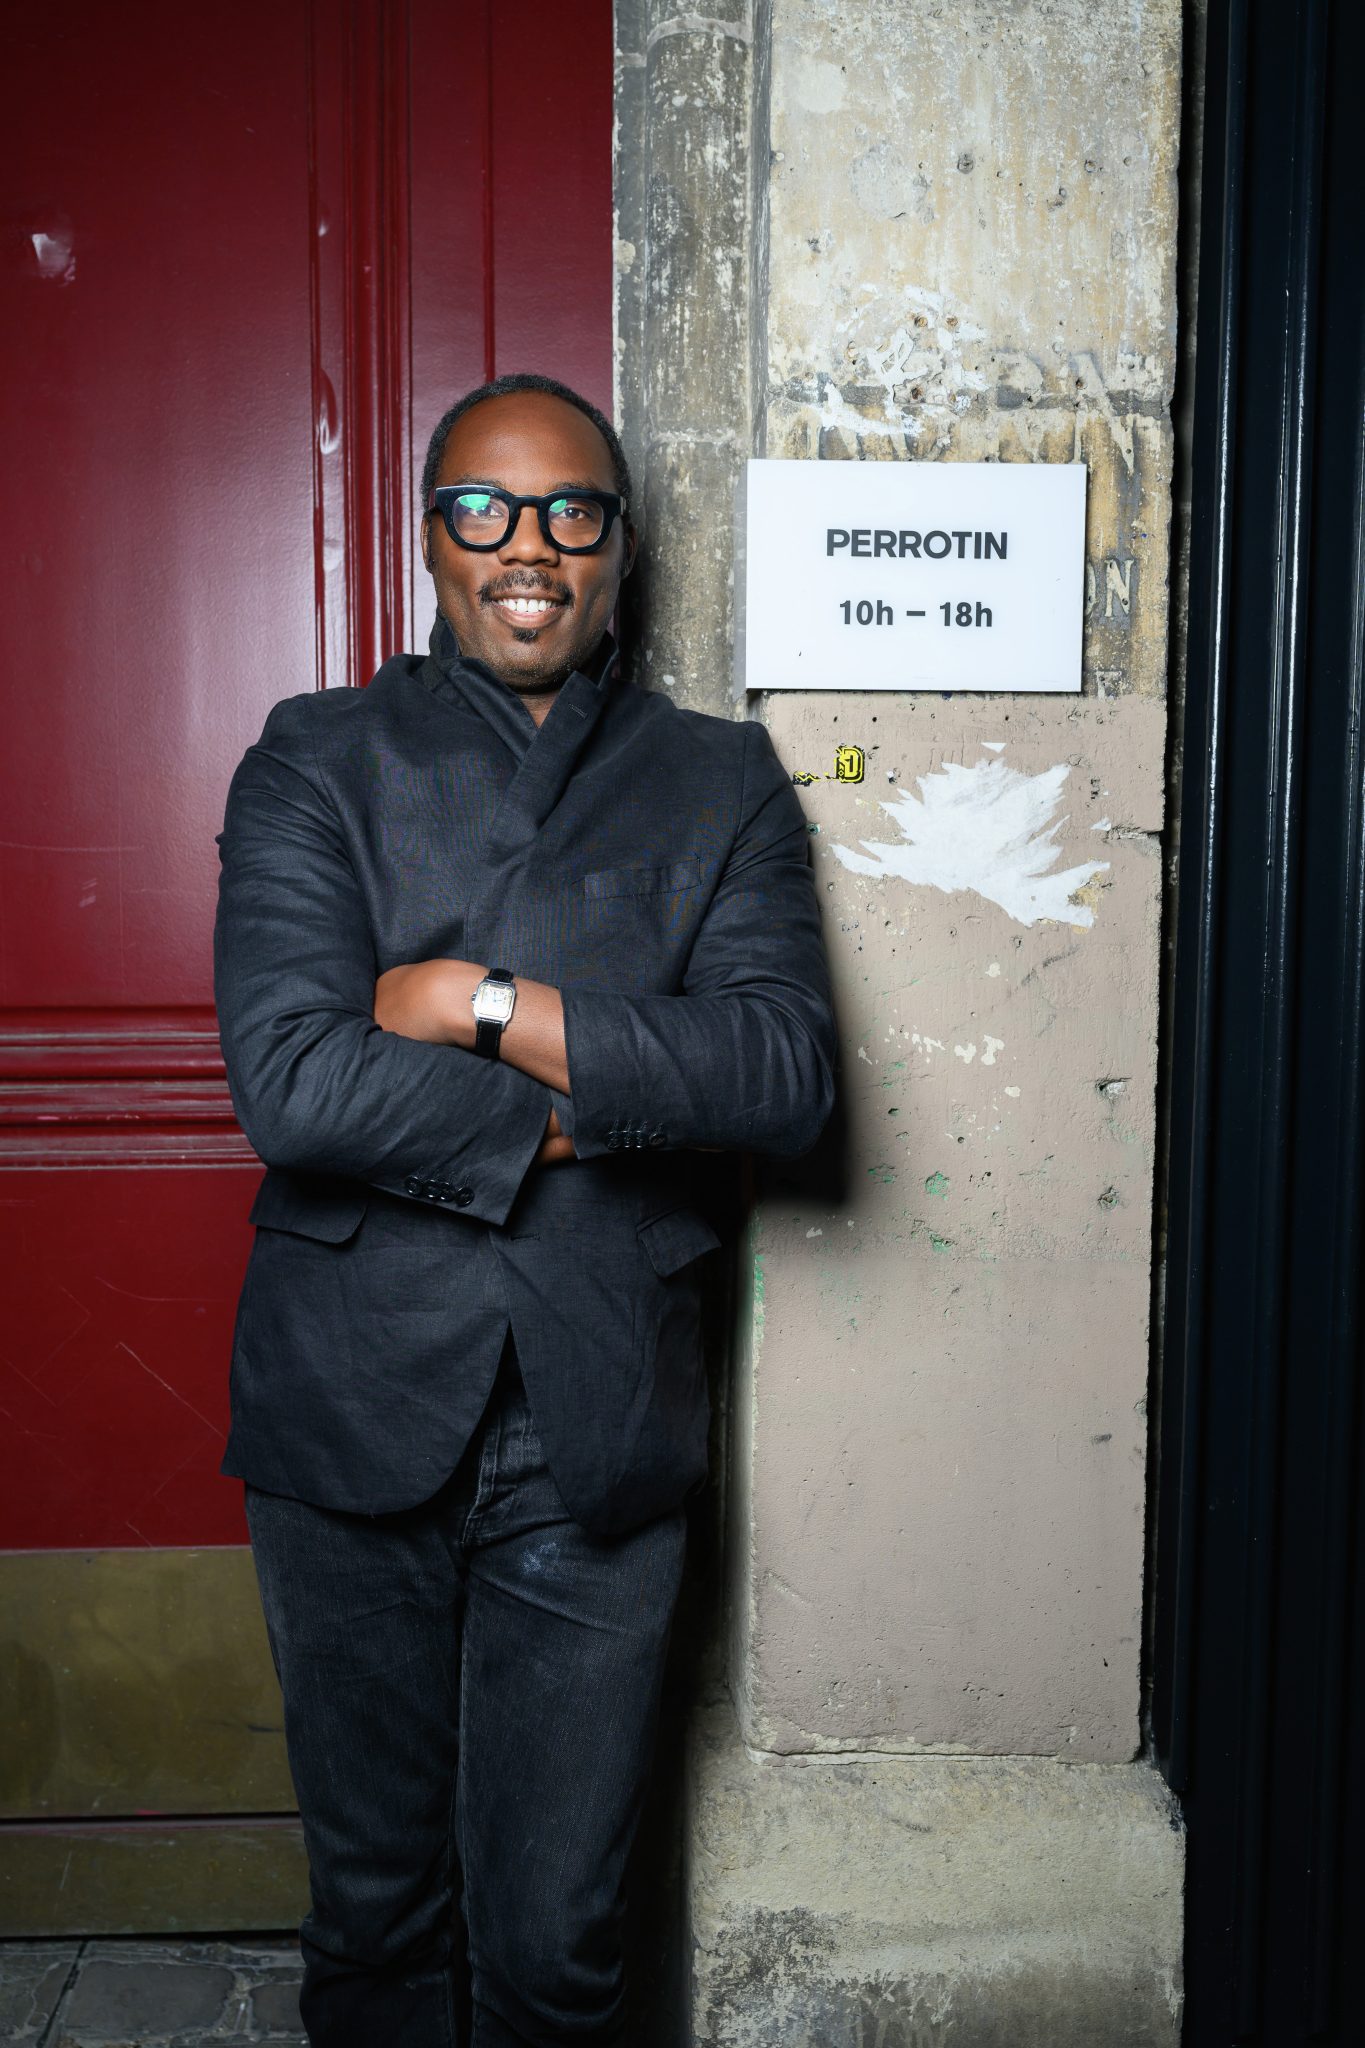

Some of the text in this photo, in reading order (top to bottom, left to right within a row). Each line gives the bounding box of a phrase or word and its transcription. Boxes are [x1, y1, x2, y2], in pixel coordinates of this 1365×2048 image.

[826, 528, 1008, 560] PERROTIN
[839, 599, 894, 626] 10h
[939, 601, 993, 627] 18h
